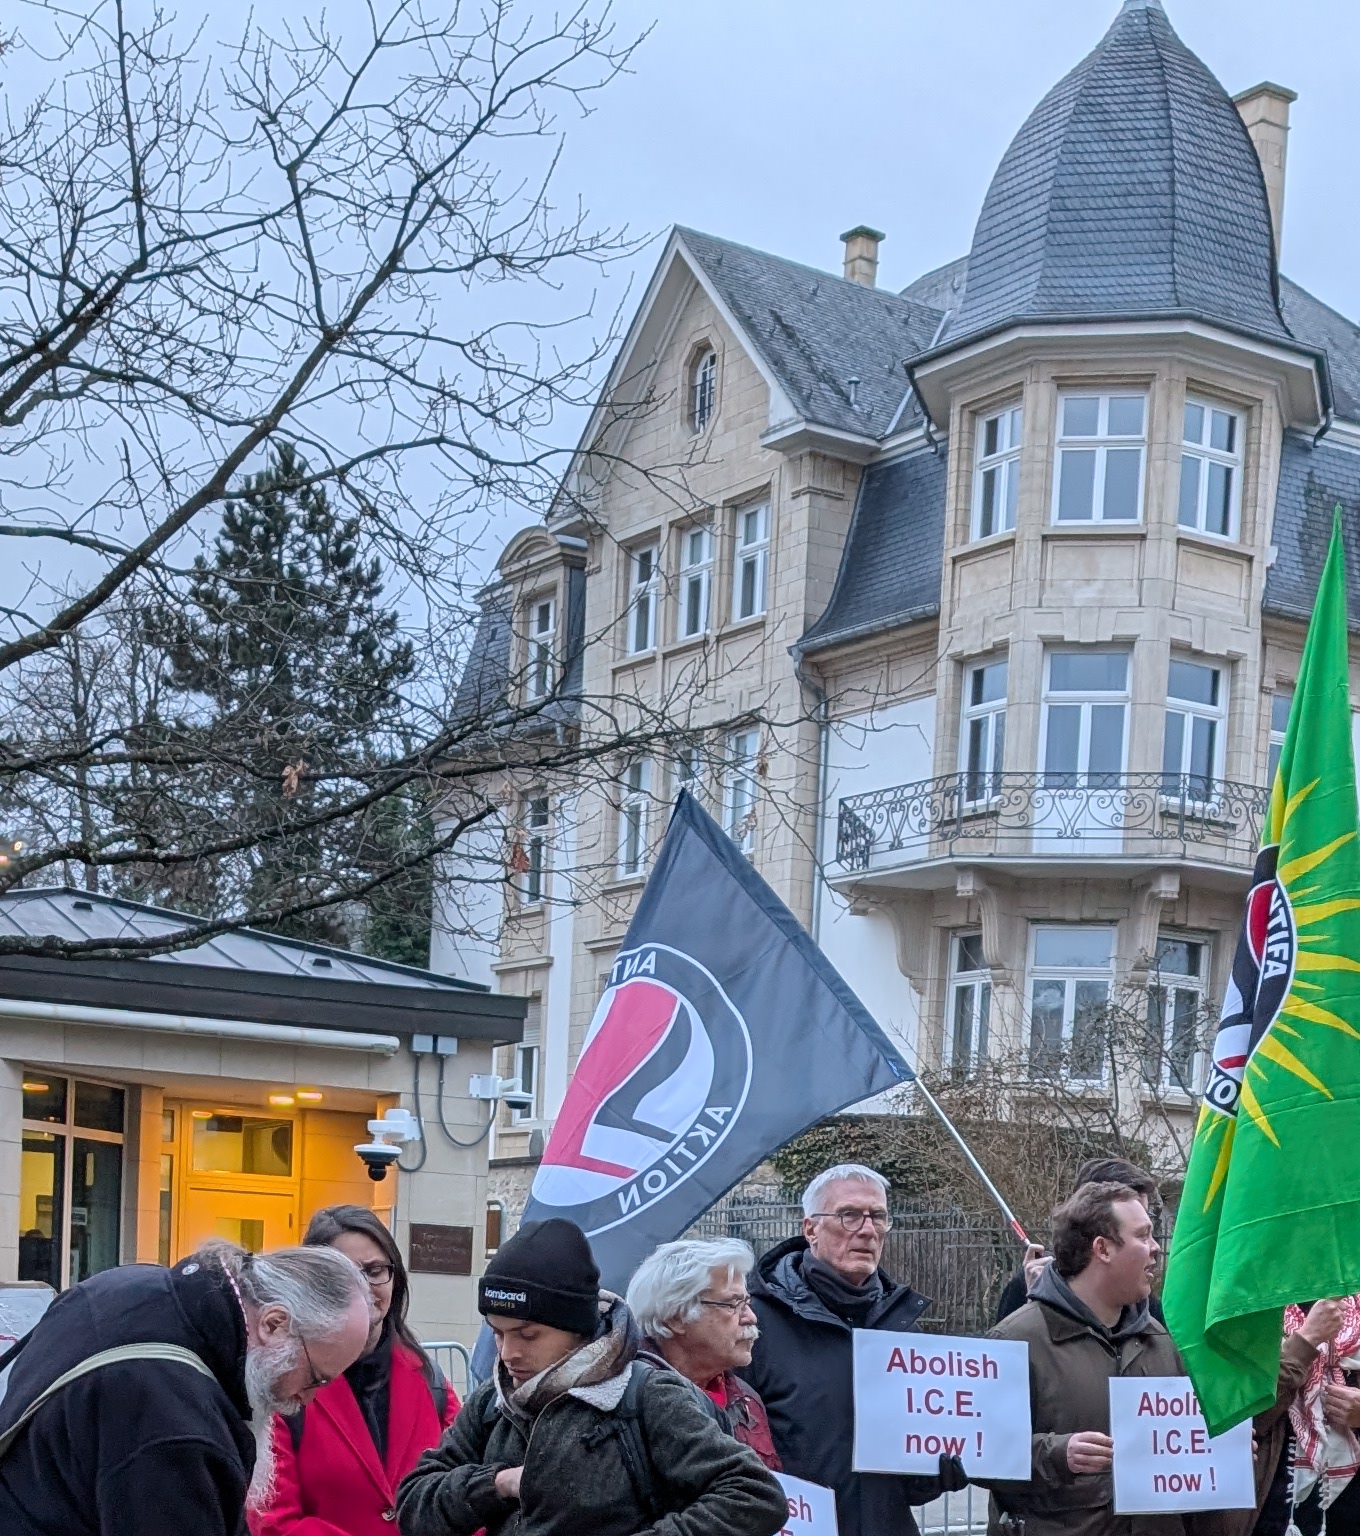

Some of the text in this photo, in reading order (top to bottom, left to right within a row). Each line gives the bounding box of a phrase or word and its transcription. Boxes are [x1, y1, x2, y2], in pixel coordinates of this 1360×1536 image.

[886, 1347, 999, 1380] Abolish
[906, 1387, 982, 1418] I.C.E.
[1137, 1391, 1205, 1417] Aboli
[905, 1431, 983, 1458] now !
[1152, 1429, 1212, 1455] I.C.E.
[1153, 1466, 1217, 1493] now !
